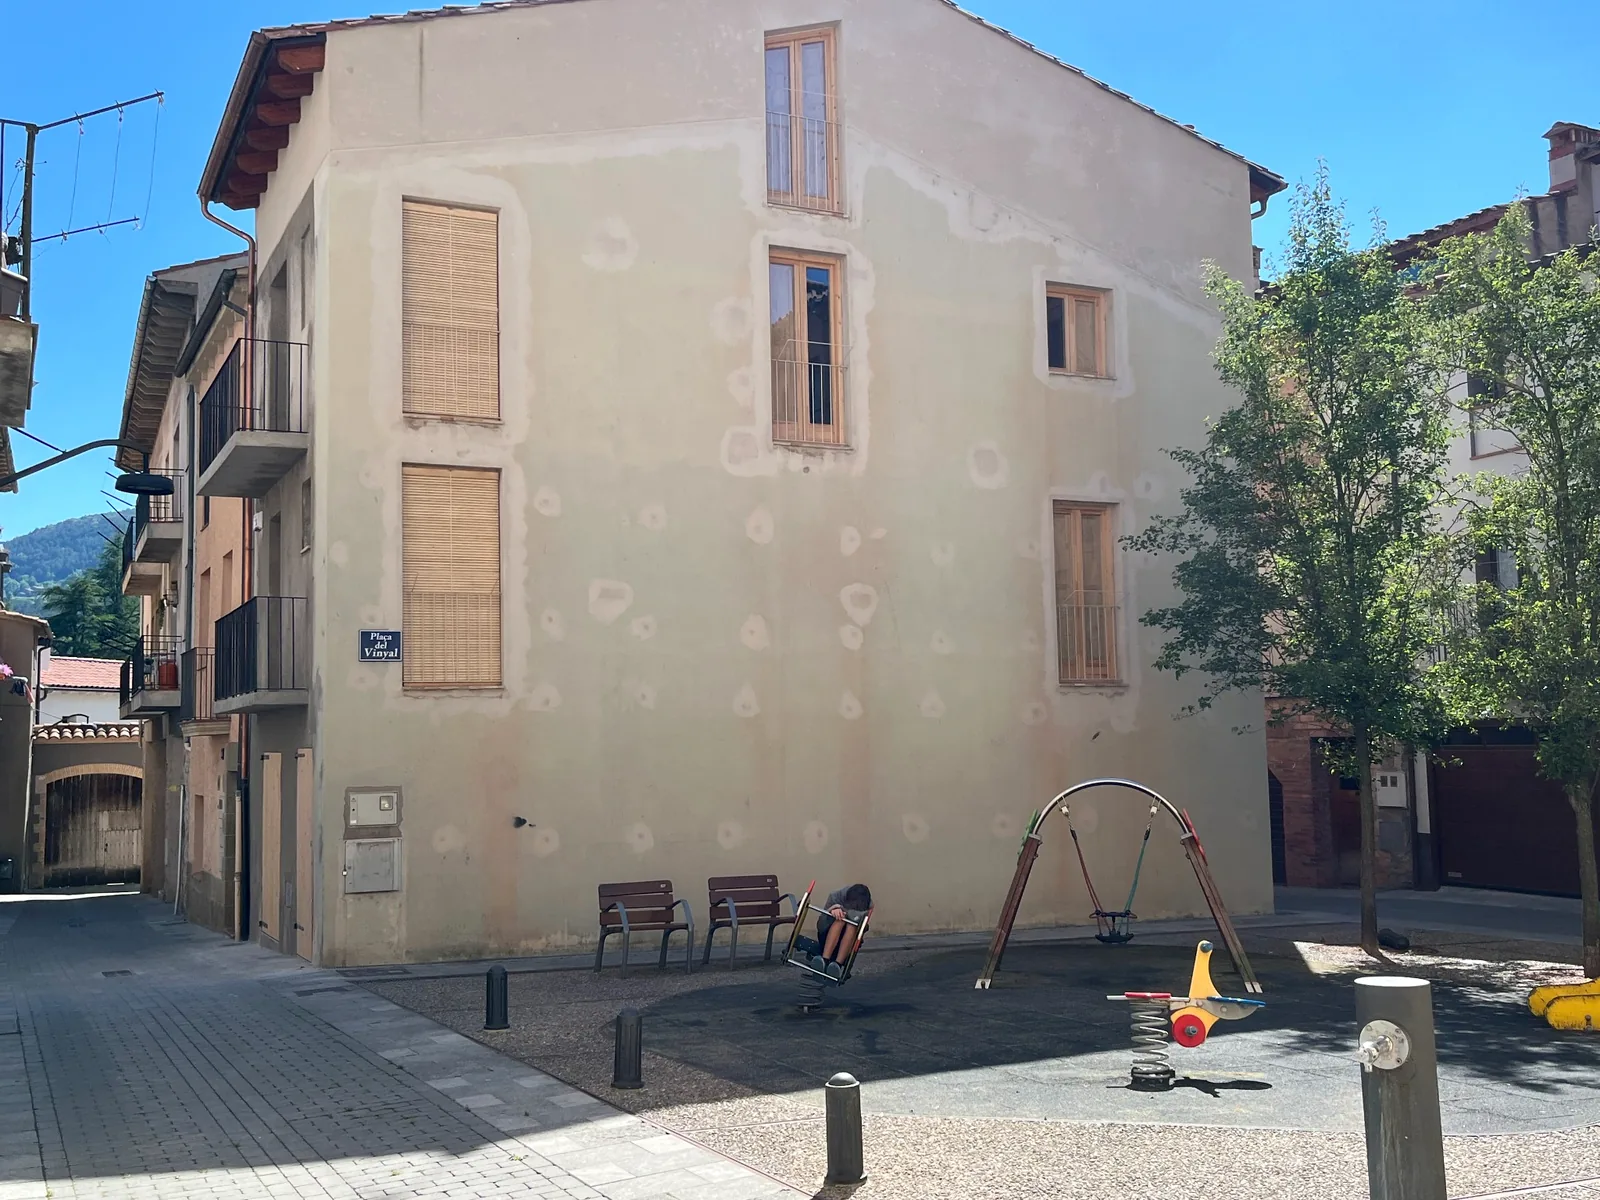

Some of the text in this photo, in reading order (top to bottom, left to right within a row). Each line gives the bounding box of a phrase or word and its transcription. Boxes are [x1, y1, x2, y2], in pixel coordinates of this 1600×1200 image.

[370, 633, 392, 642] Plaça
[374, 641, 387, 649] del
[364, 648, 398, 660] Vinyal
